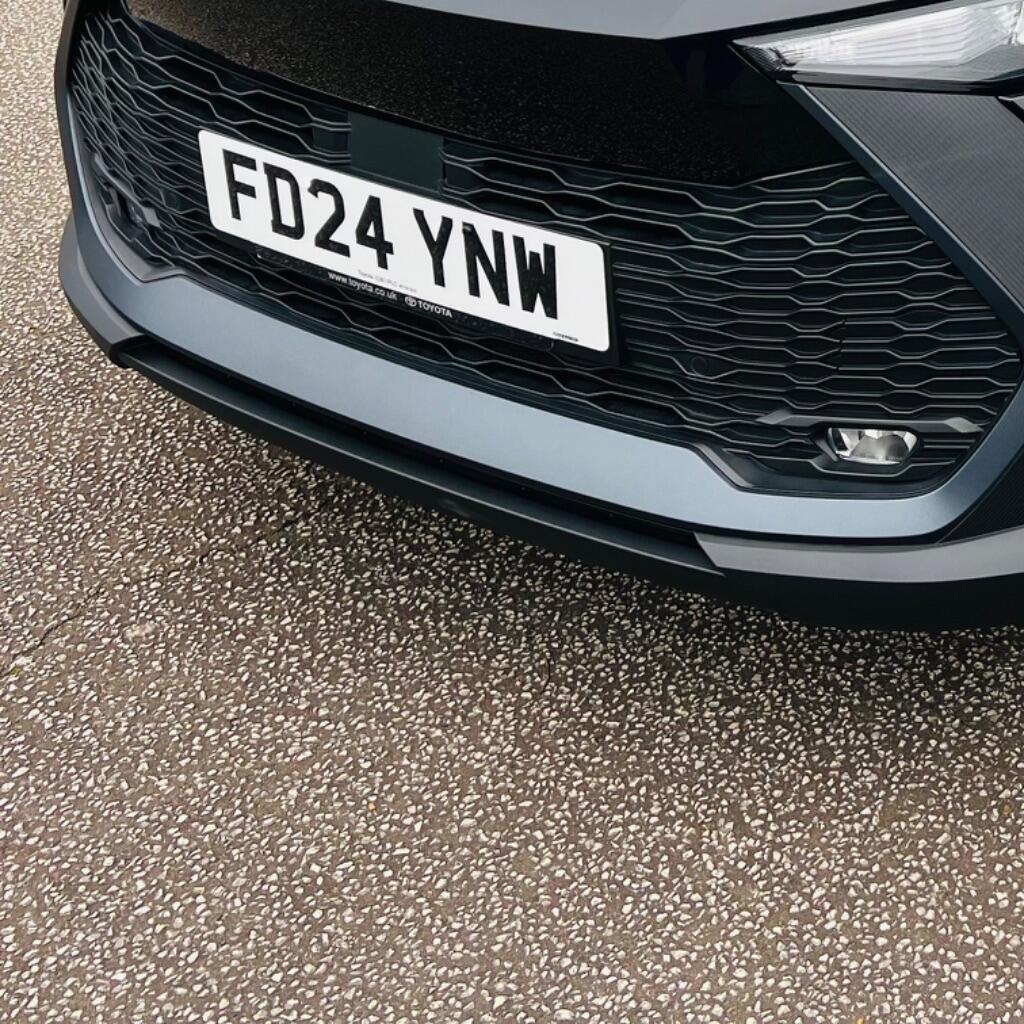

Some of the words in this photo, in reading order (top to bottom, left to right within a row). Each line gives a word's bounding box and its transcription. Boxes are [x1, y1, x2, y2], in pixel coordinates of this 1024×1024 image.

[221, 148, 395, 270] FD24
[412, 207, 559, 320] YNW
[327, 271, 398, 301] www.toyota.co.uk
[417, 300, 454, 318] TOYOTA
